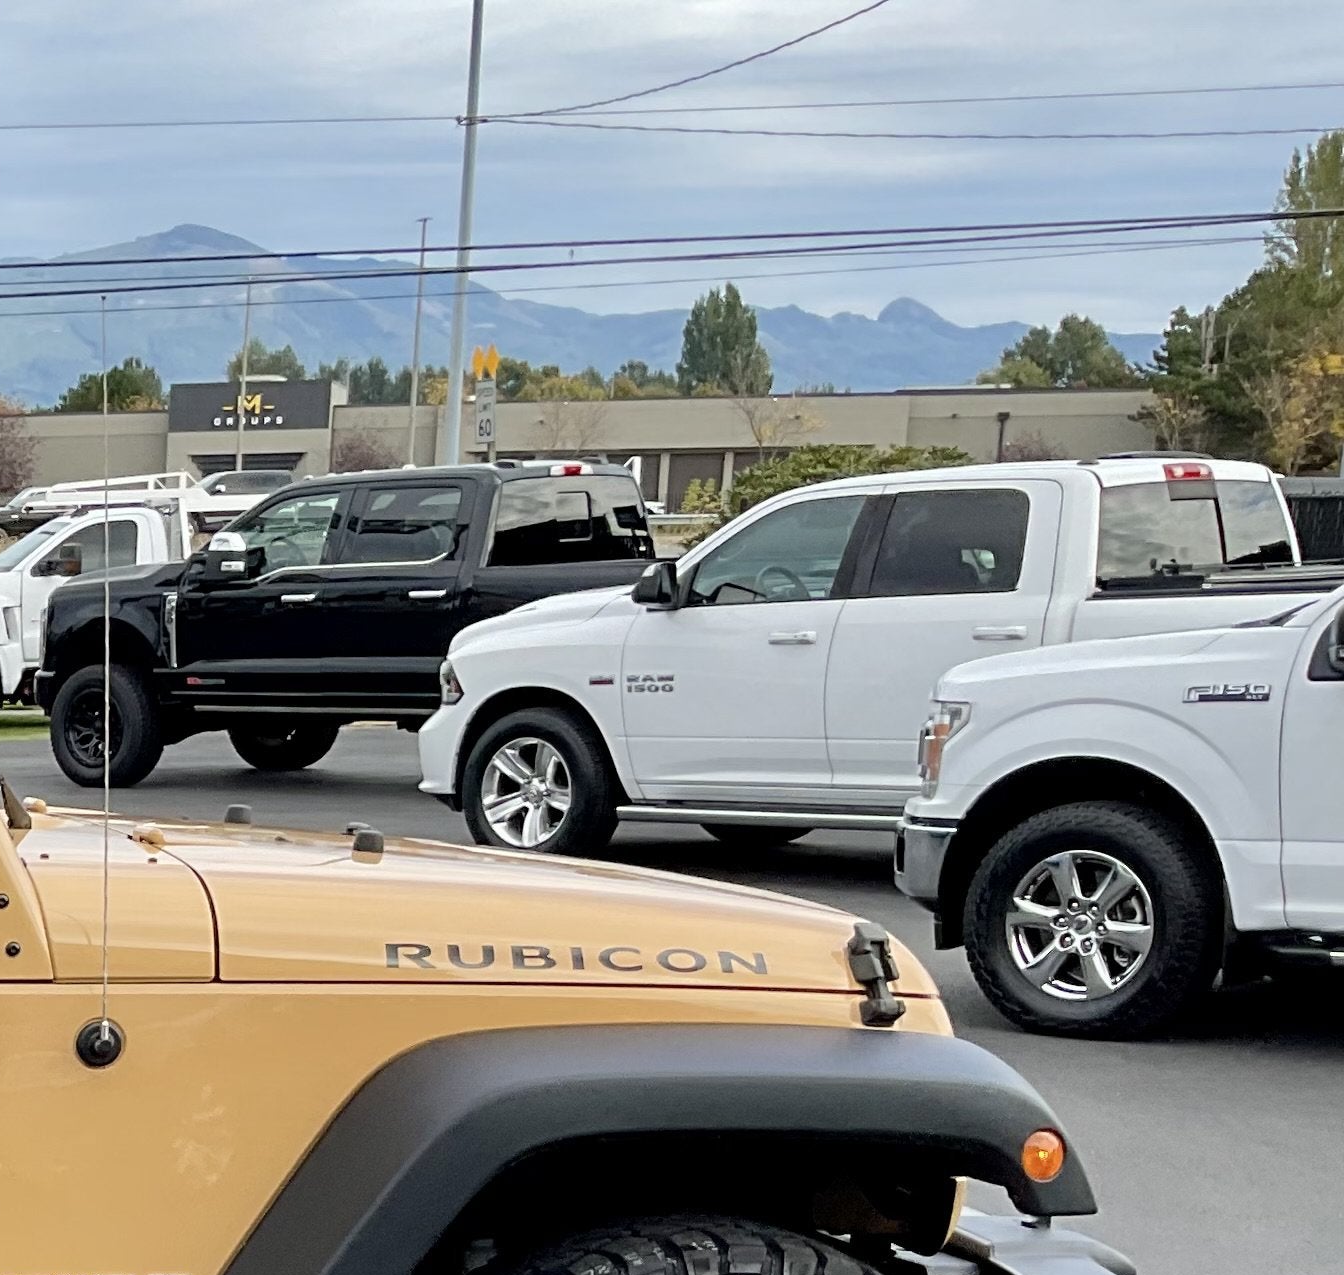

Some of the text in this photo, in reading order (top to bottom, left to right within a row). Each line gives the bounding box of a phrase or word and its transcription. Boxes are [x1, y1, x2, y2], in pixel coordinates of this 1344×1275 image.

[478, 418, 492, 437] 60
[626, 674, 674, 683] RAM
[627, 683, 674, 693] 1500
[384, 943, 769, 976] RUBICON
